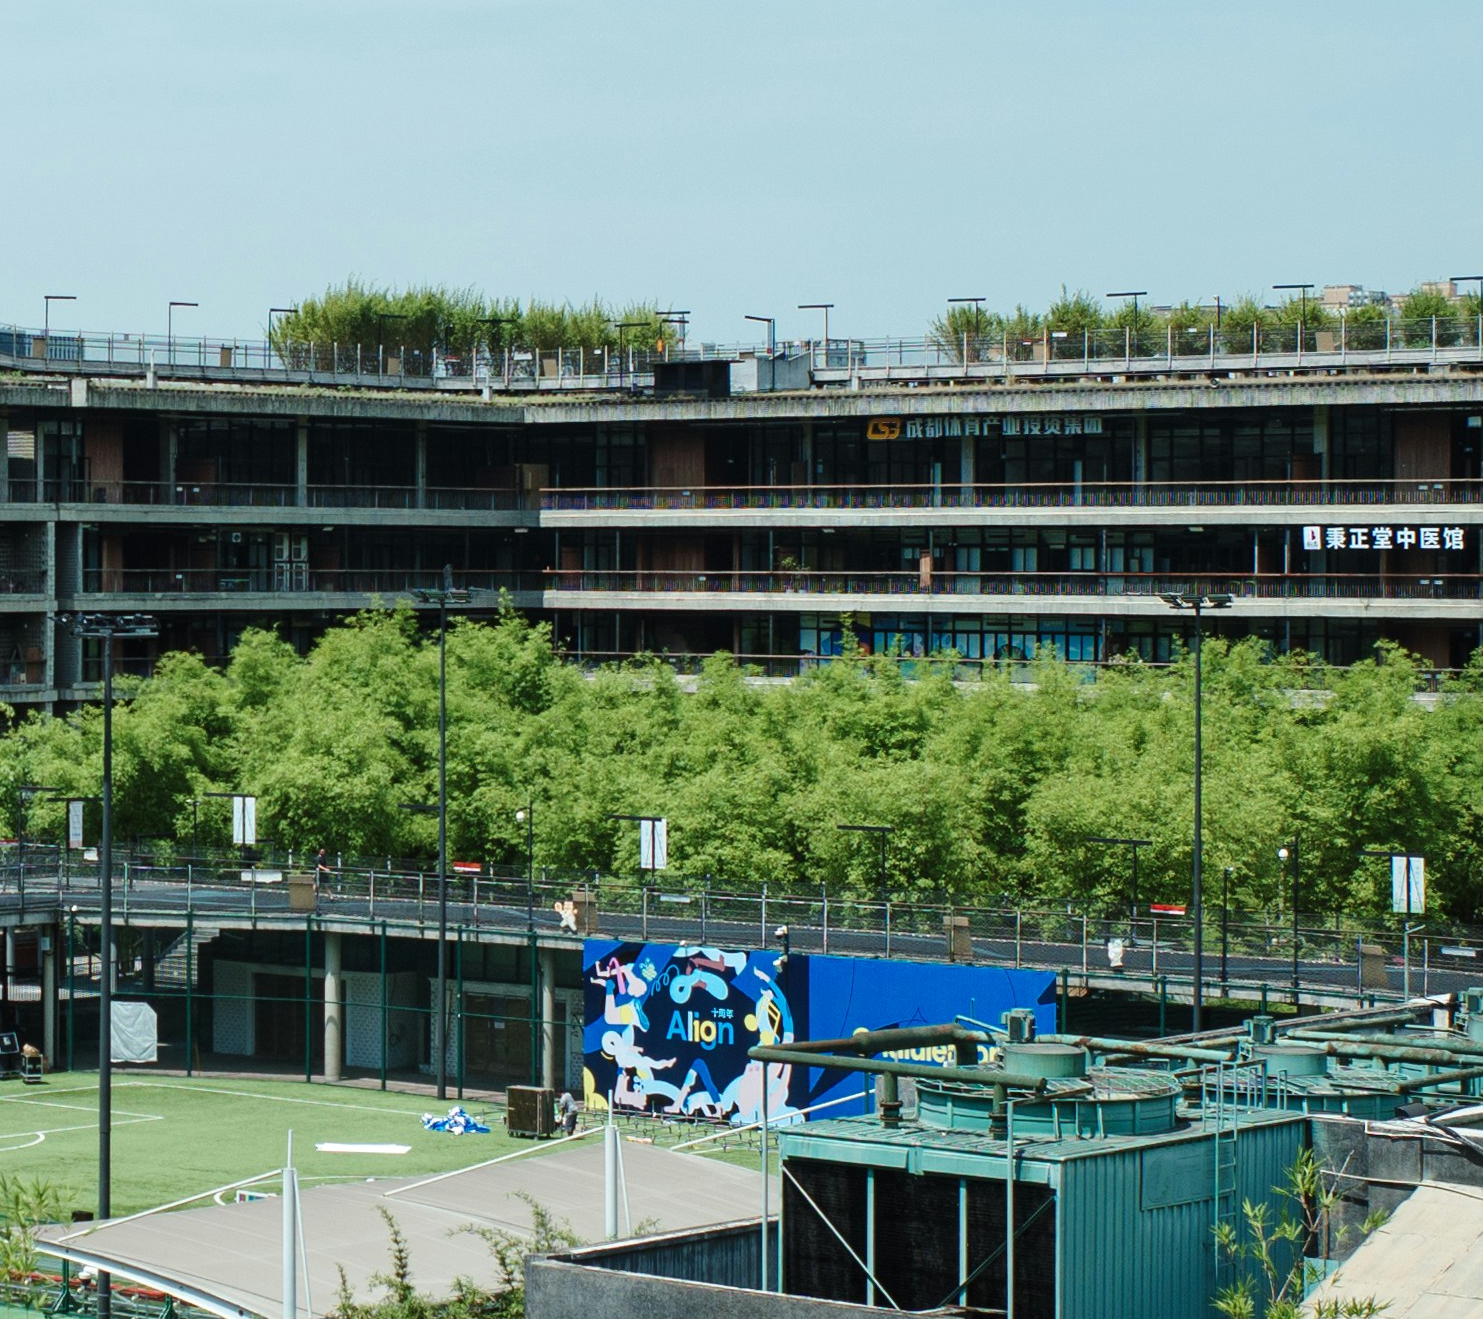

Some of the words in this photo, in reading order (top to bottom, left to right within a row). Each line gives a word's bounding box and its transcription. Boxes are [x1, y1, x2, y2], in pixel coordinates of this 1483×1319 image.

[906, 416, 1102, 438] 成都体育产业投资集团
[1326, 527, 1464, 550] 秉正堂中医馆
[711, 1007, 734, 1019] 十周年
[666, 1010, 734, 1051] Align
